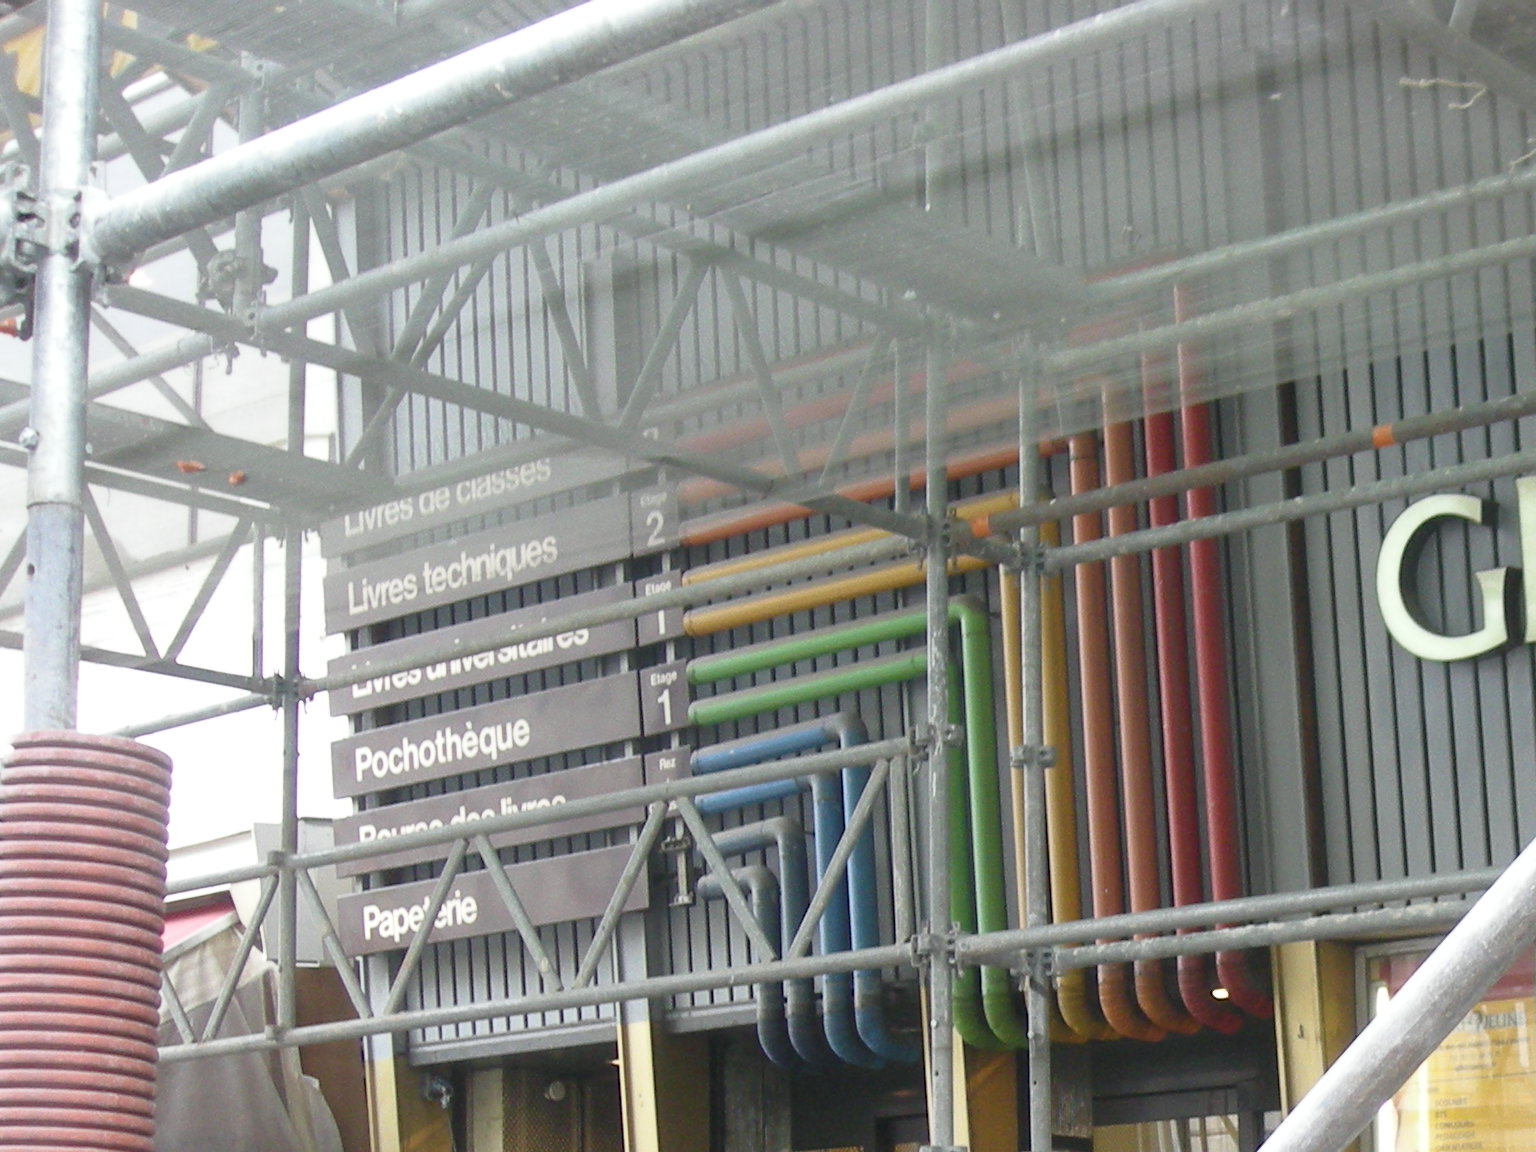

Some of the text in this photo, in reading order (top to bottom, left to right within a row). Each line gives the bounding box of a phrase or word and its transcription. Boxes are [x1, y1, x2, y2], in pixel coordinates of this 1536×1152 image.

[646, 510, 666, 548] 2
[347, 534, 558, 616] Livres techniques
[644, 580, 672, 597] Etage
[650, 670, 678, 687] Etage
[656, 689, 672, 726] 1
[354, 717, 531, 783] Pochothèque
